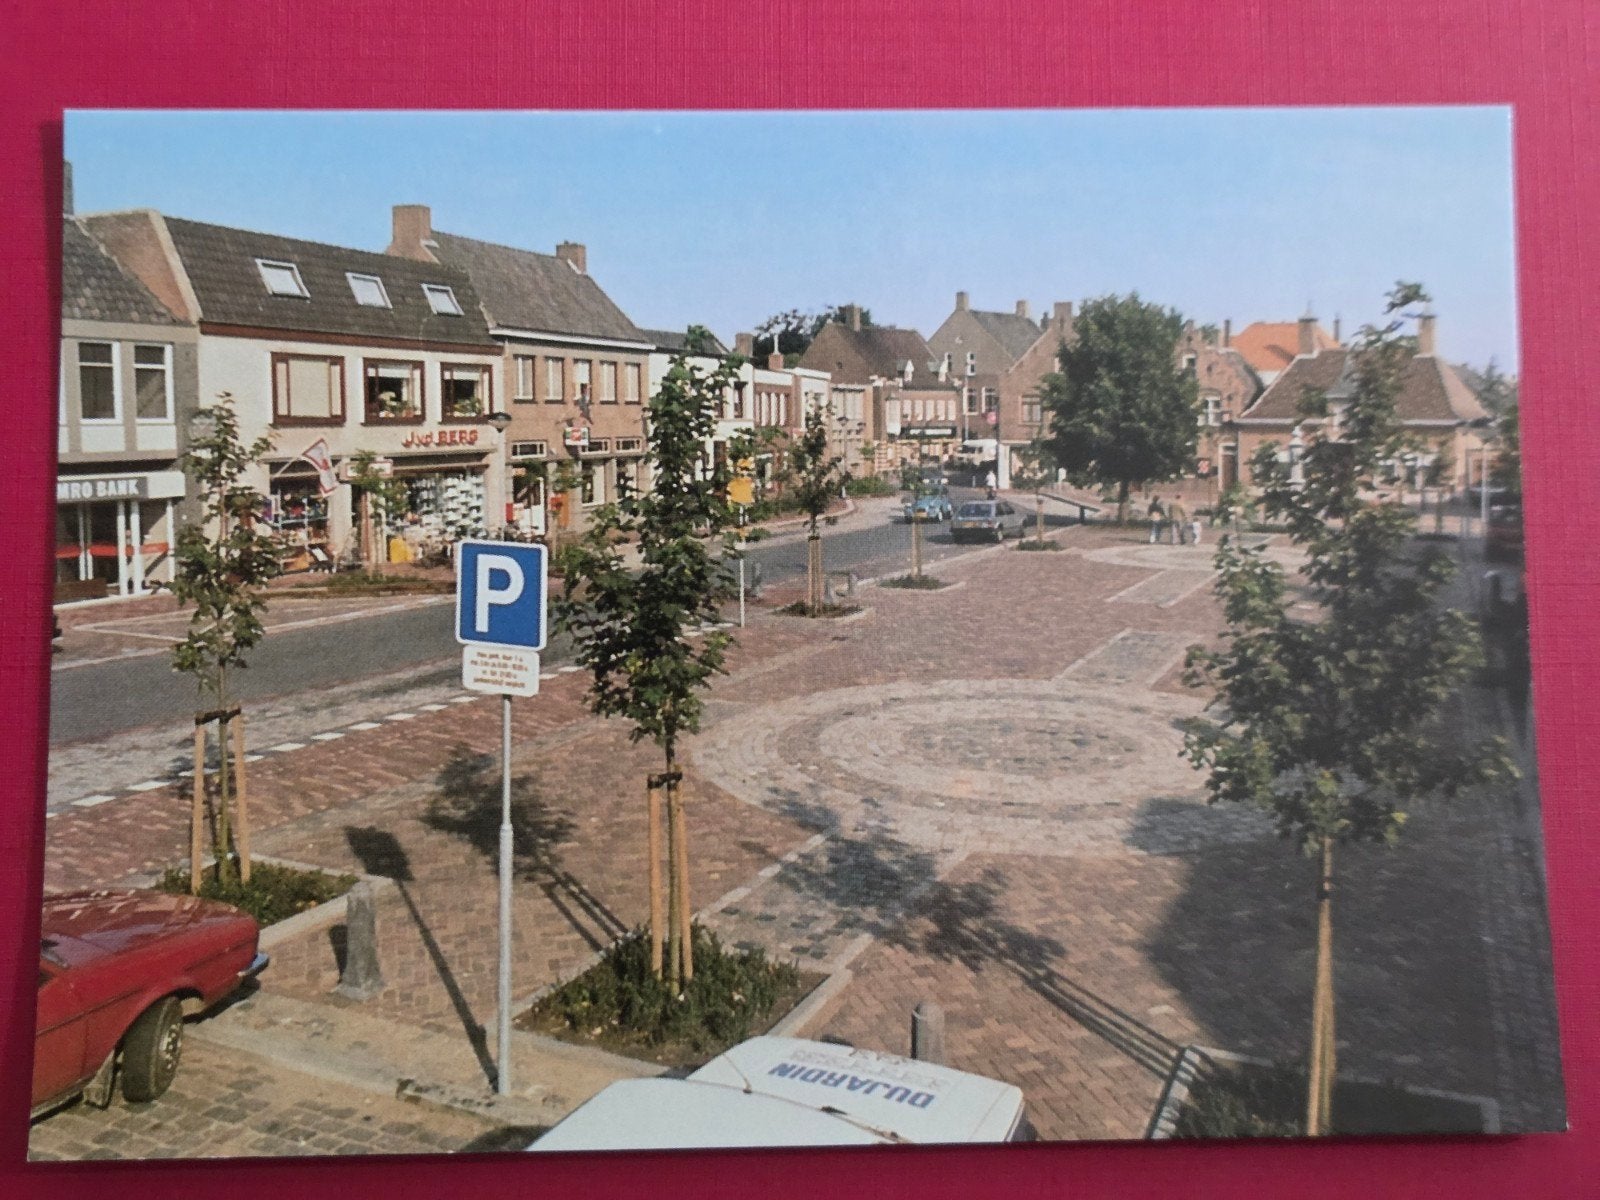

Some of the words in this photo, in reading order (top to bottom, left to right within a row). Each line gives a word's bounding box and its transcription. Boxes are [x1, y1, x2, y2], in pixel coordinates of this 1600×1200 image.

[437, 429, 479, 446] BERG
[96, 479, 139, 498] BANK
[475, 553, 525, 633] P
[768, 1062, 936, 1109] DUJARDIN
